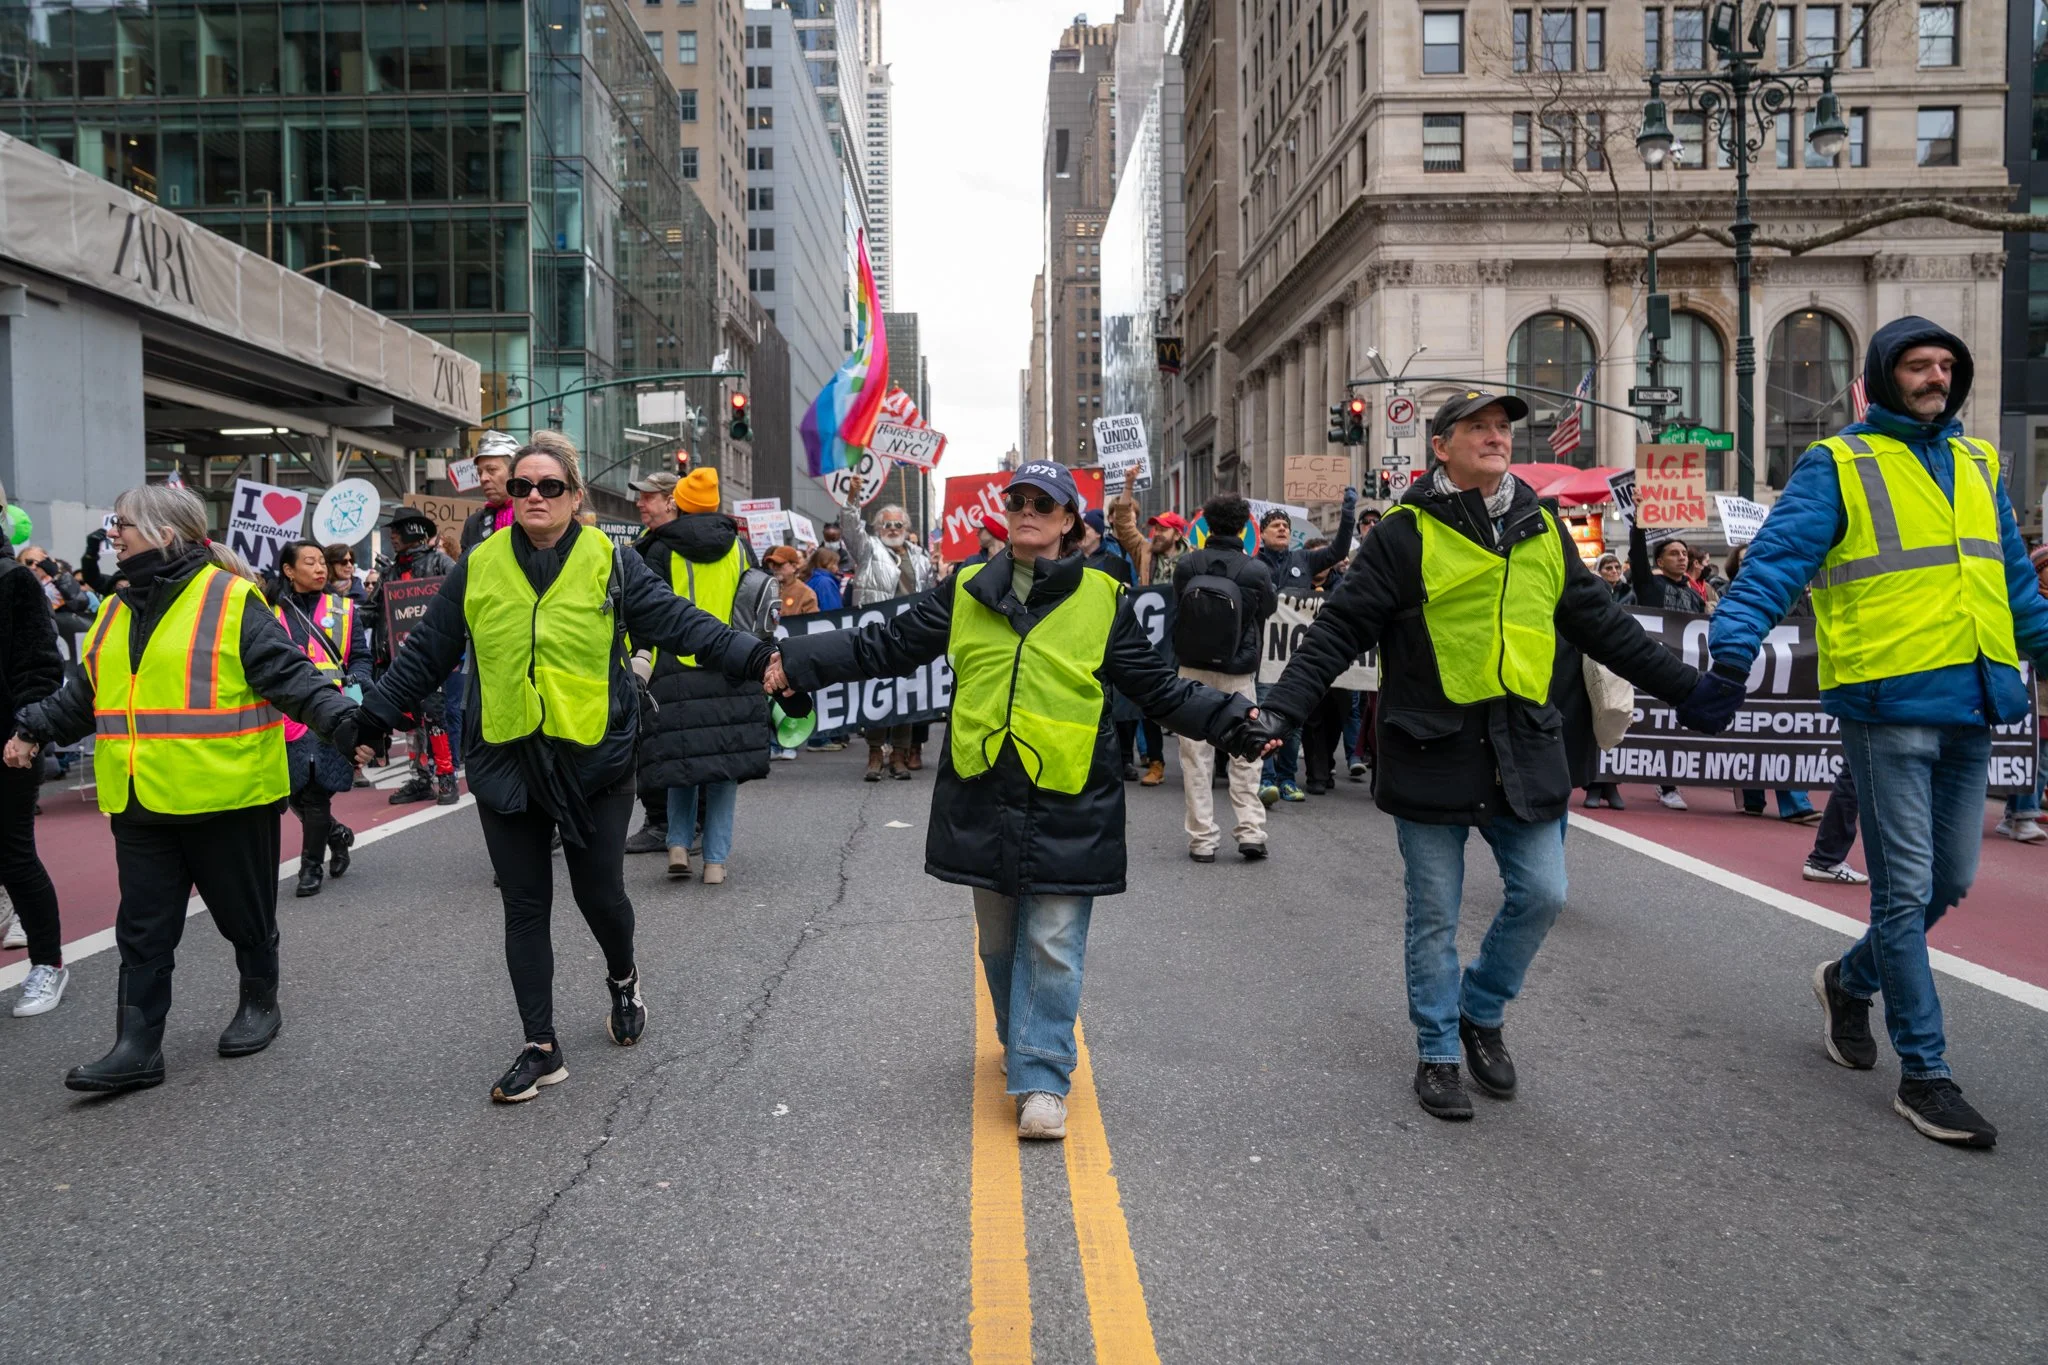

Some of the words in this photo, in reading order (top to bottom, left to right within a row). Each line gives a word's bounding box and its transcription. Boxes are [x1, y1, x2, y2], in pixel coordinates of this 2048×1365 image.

[108, 202, 194, 305] ZARA
[433, 352, 468, 411] ZARA
[1112, 416, 1140, 429] PUEBLO
[1103, 426, 1139, 444] UNIDO
[1704, 438, 1724, 447] Ave
[886, 439, 930, 457] NYC!
[1024, 464, 1058, 479] 1973
[1107, 461, 1121, 470] LAS
[1640, 484, 1703, 502] WILL
[237, 486, 262, 520] I
[1642, 500, 1706, 525] BURN
[231, 519, 300, 540] IMMIGRANT
[600, 523, 626, 535] HANDS
[627, 525, 641, 536] OFF
[389, 589, 405, 600] NO
[406, 582, 442, 598] KINGS
[1599, 746, 1668, 778] FUERA
[1671, 751, 1701, 780] DE
[1704, 752, 1755, 782] NYC!
[1759, 753, 1791, 783] NO
[1794, 747, 1845, 784] MÁS
